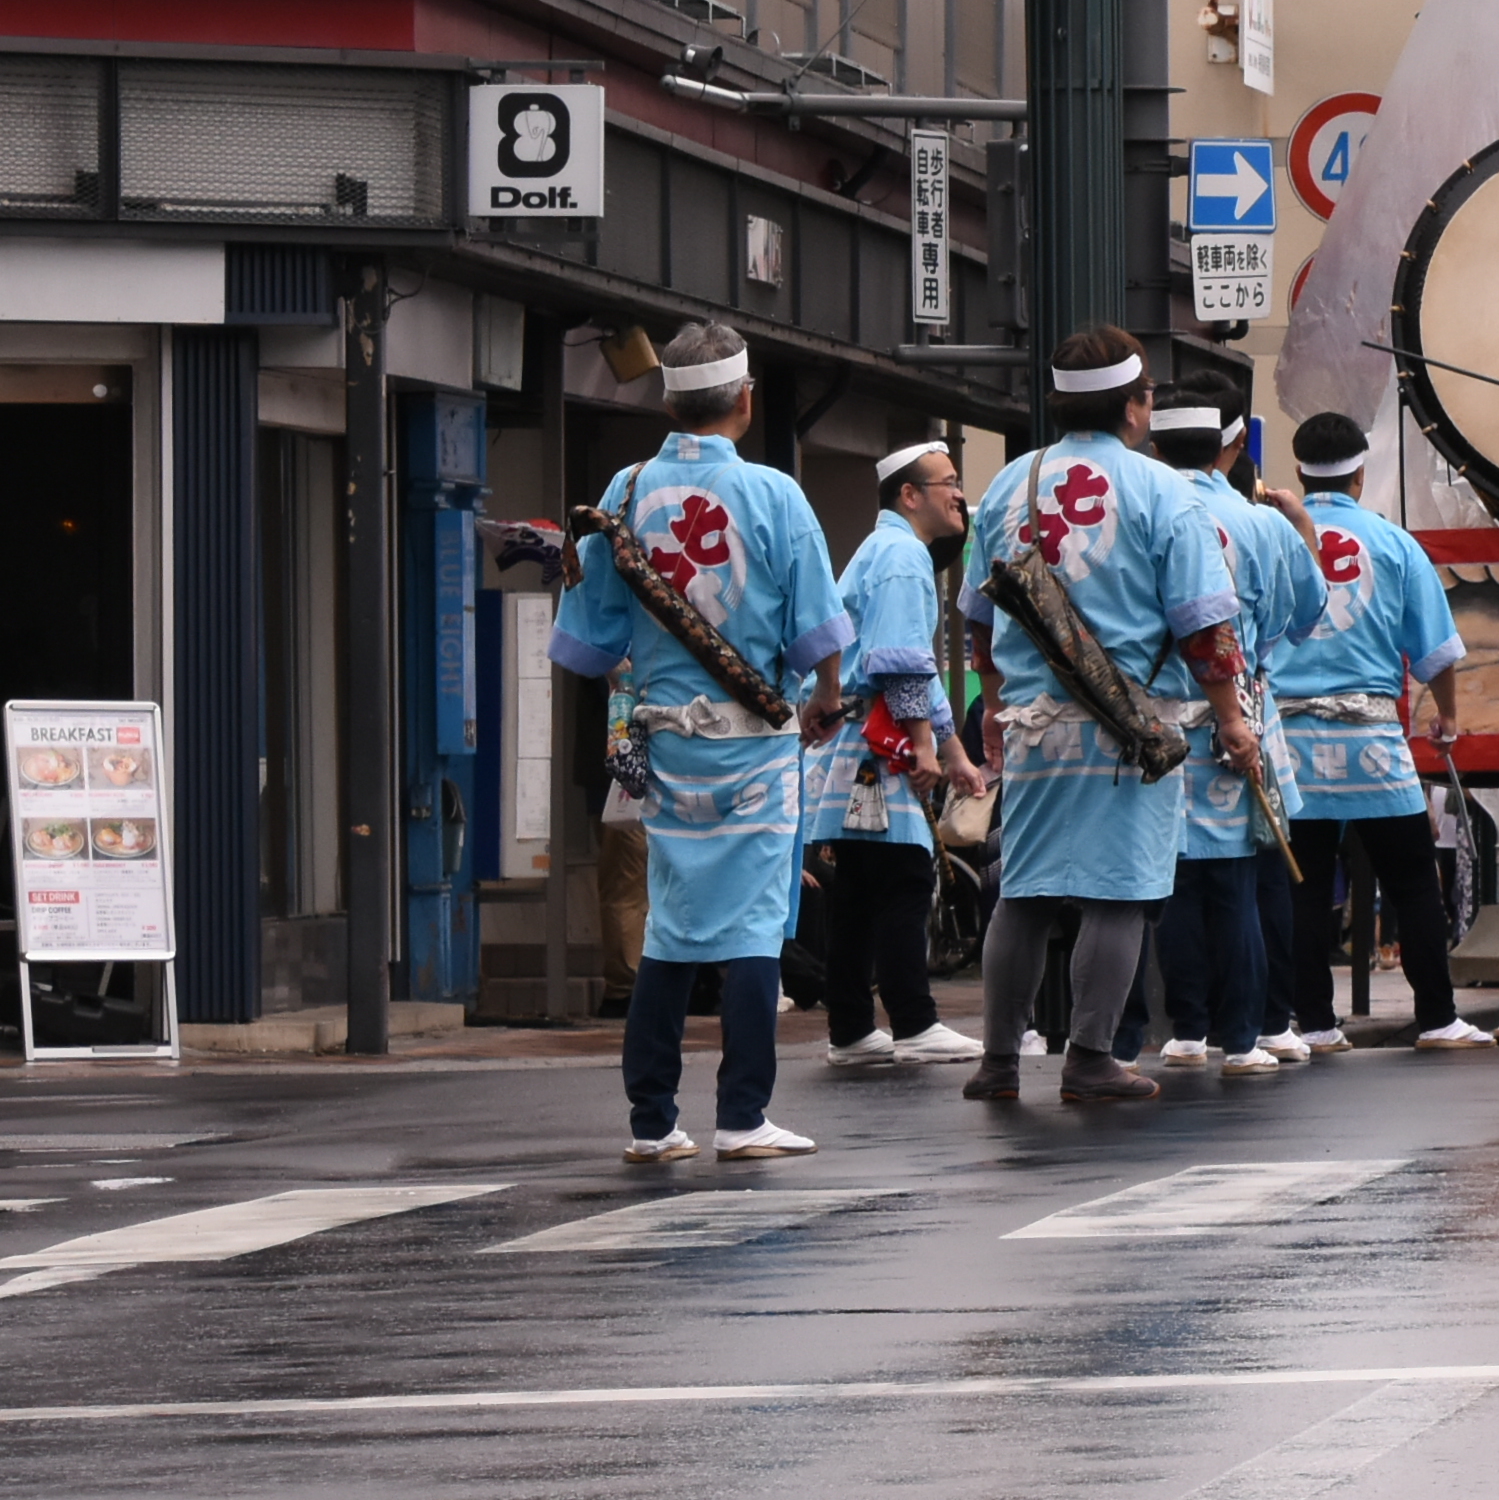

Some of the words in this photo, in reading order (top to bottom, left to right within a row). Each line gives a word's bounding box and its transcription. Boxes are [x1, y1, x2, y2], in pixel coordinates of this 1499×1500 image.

[1322, 131, 1367, 187] 4
[490, 186, 578, 209] Dolf.
[916, 146, 929, 238] 自転車
[930, 148, 944, 239] 歩行者
[1197, 243, 1267, 273] 軽車両を除く
[921, 241, 940, 310] 専用
[1203, 282, 1265, 309] ここから
[31, 727, 113, 742] BREAKFAST
[48, 892, 77, 902] DRINK
